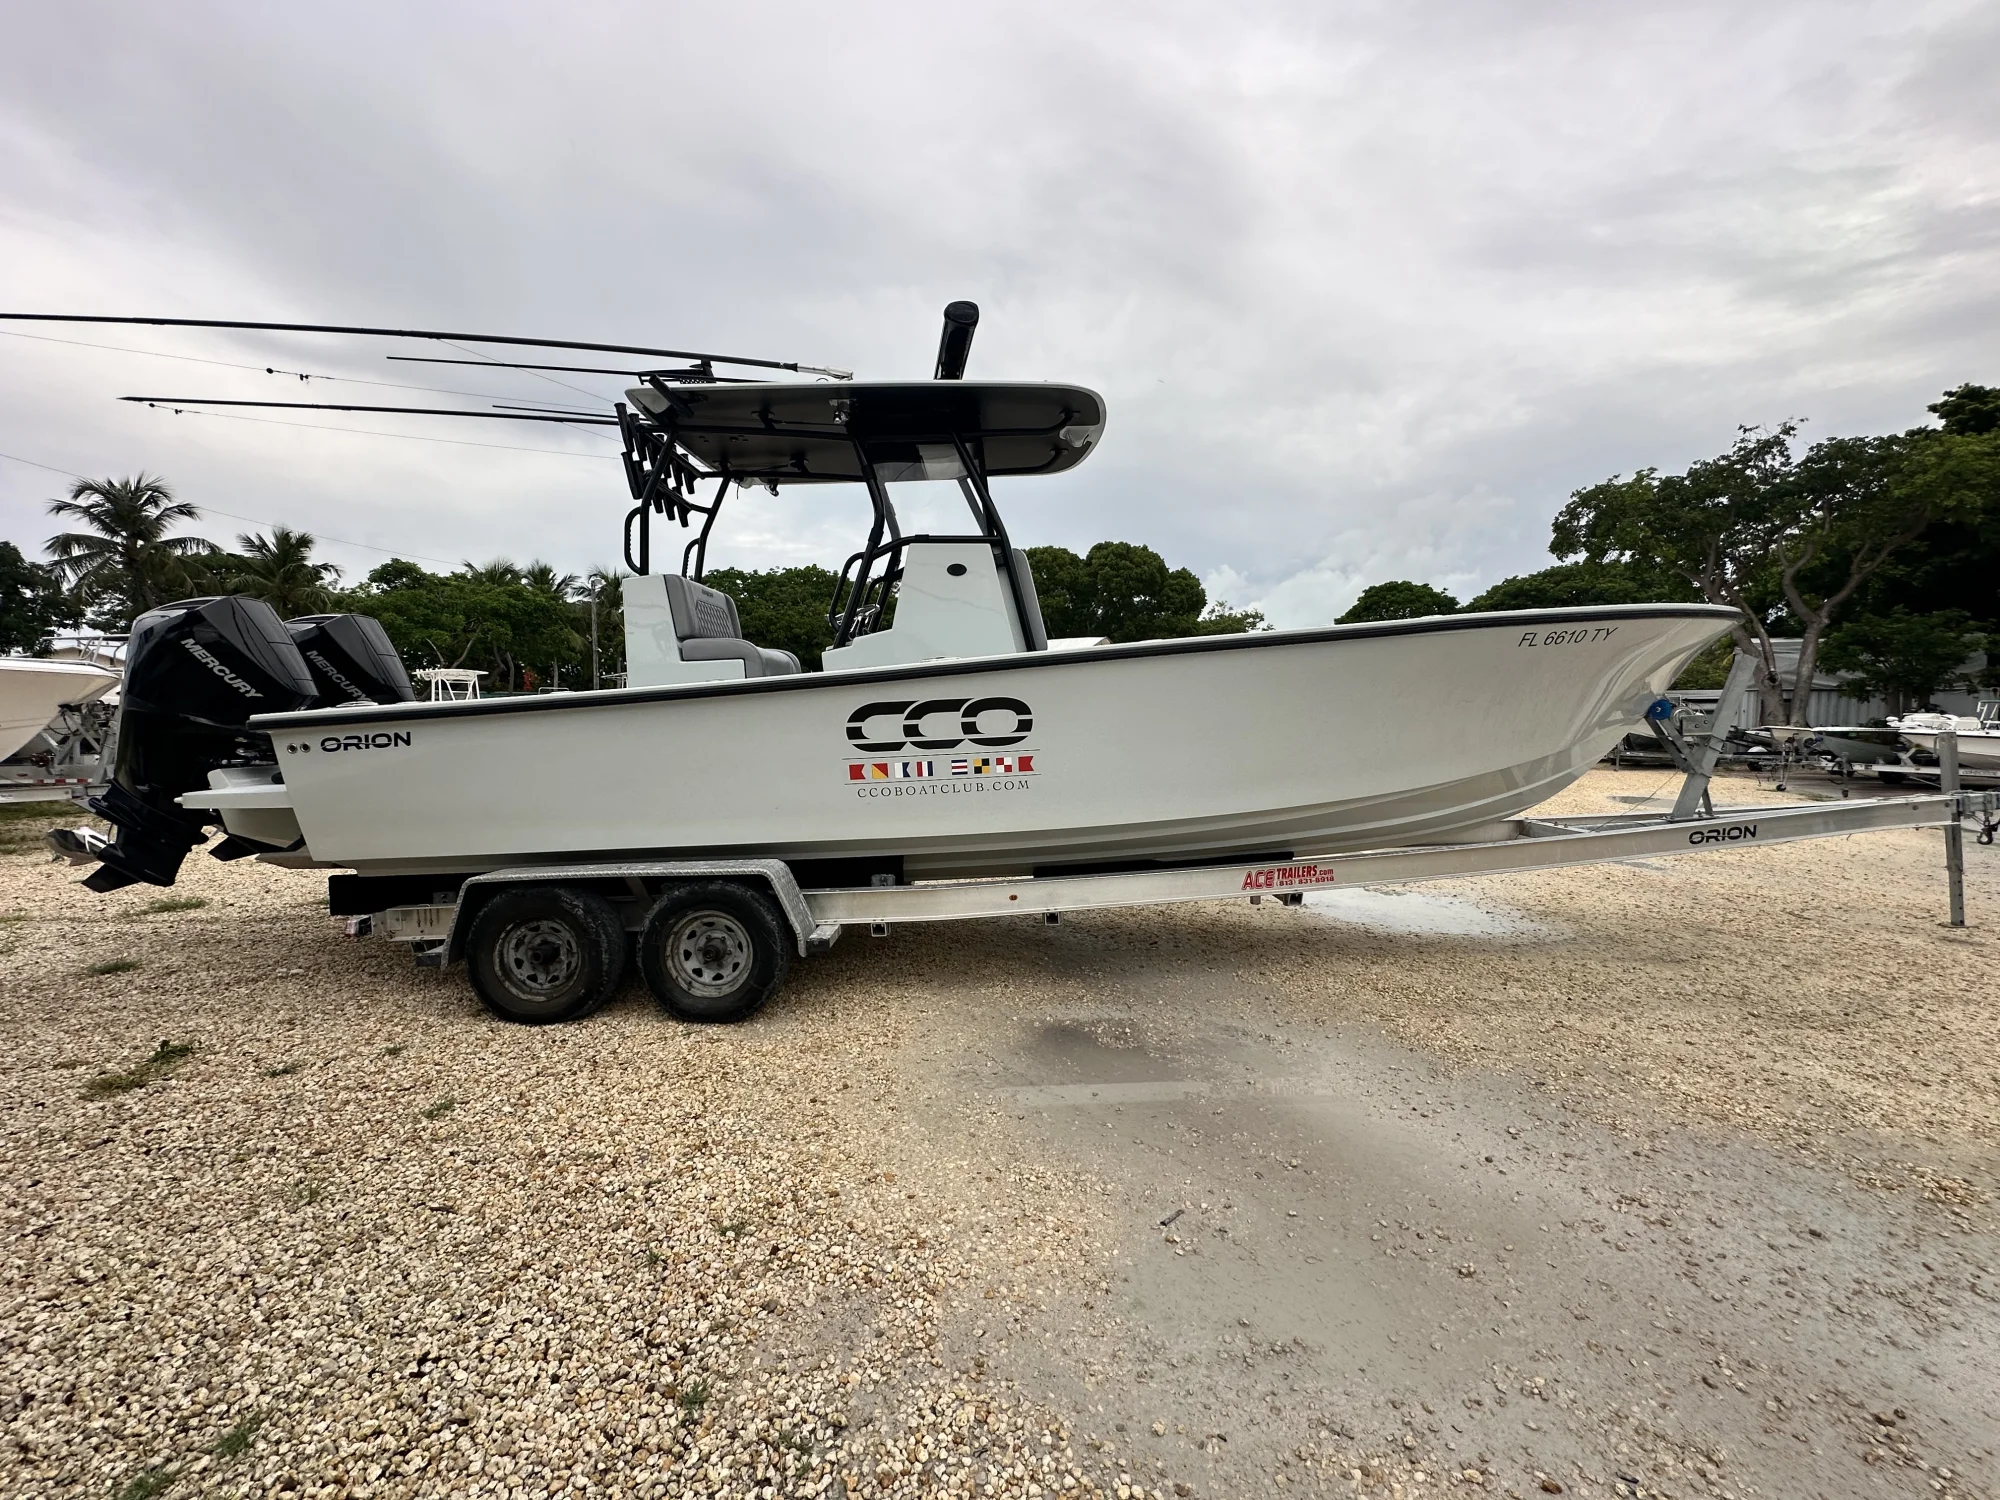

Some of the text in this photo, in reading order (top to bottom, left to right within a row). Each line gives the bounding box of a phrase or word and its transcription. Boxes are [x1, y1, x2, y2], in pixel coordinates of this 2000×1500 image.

[1518, 626, 1619, 647] FL 6610 TY
[180, 638, 264, 698] MERCURY
[306, 650, 372, 703] MERCURY
[845, 696, 1034, 752] CCO
[320, 731, 411, 752] ORION
[857, 780, 1030, 798] CCOBOATCLUB.COM
[1688, 824, 1757, 845] ORION
[1241, 868, 1276, 890] ACE
